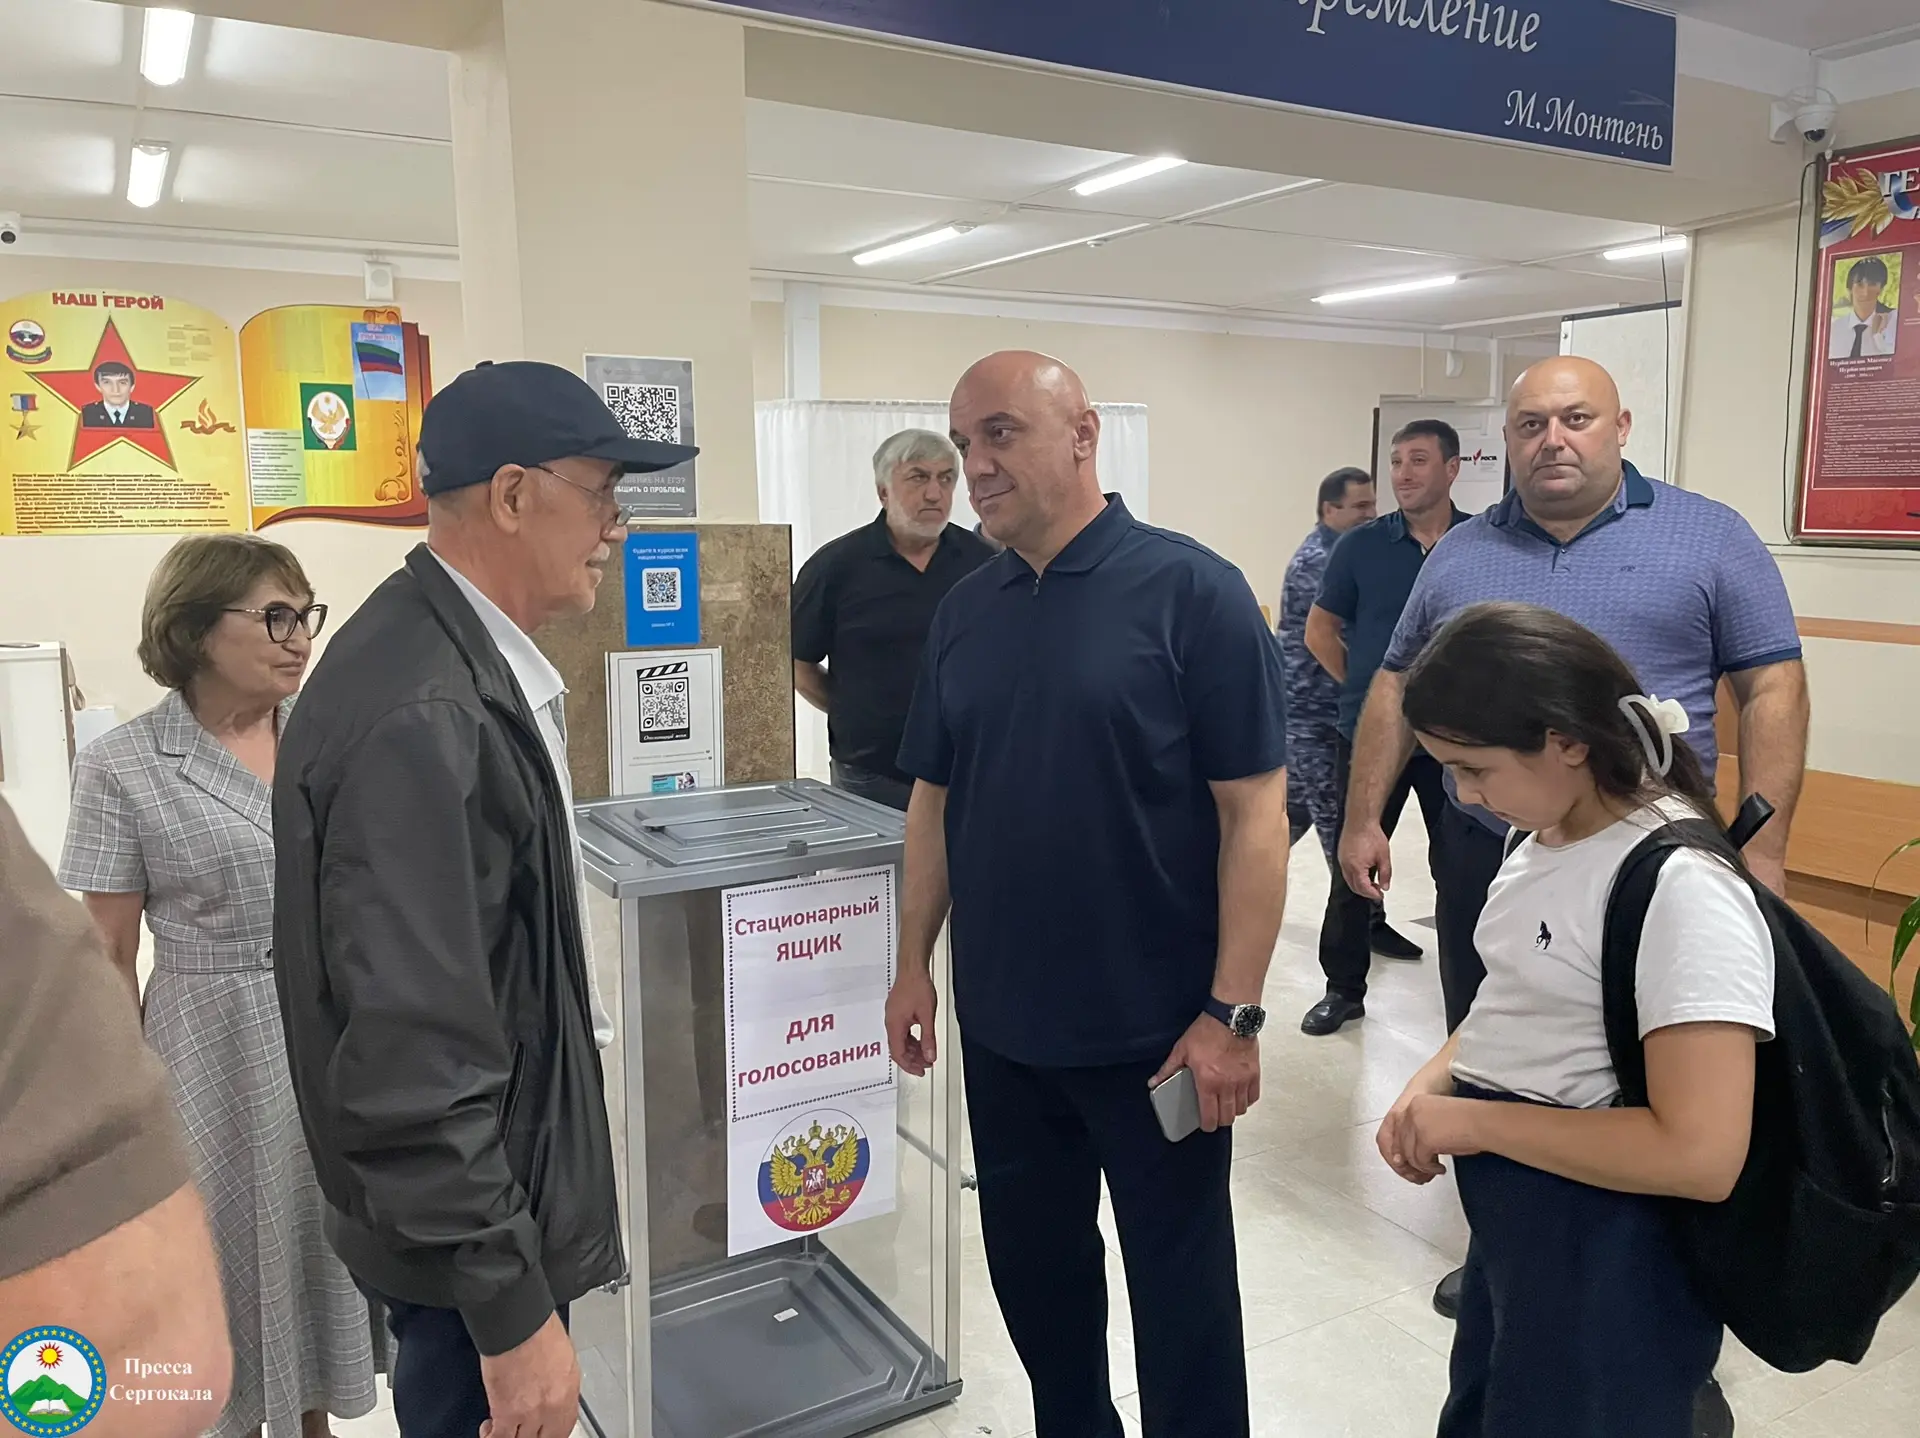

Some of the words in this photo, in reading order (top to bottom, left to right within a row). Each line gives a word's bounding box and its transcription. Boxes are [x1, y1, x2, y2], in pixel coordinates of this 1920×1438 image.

[1504, 90, 1663, 150] М.Монтень
[52, 292, 97, 306] НАШ
[103, 295, 164, 310] ГЕРОЙ
[734, 895, 880, 936] Стационарный
[738, 1041, 882, 1088] голосования
